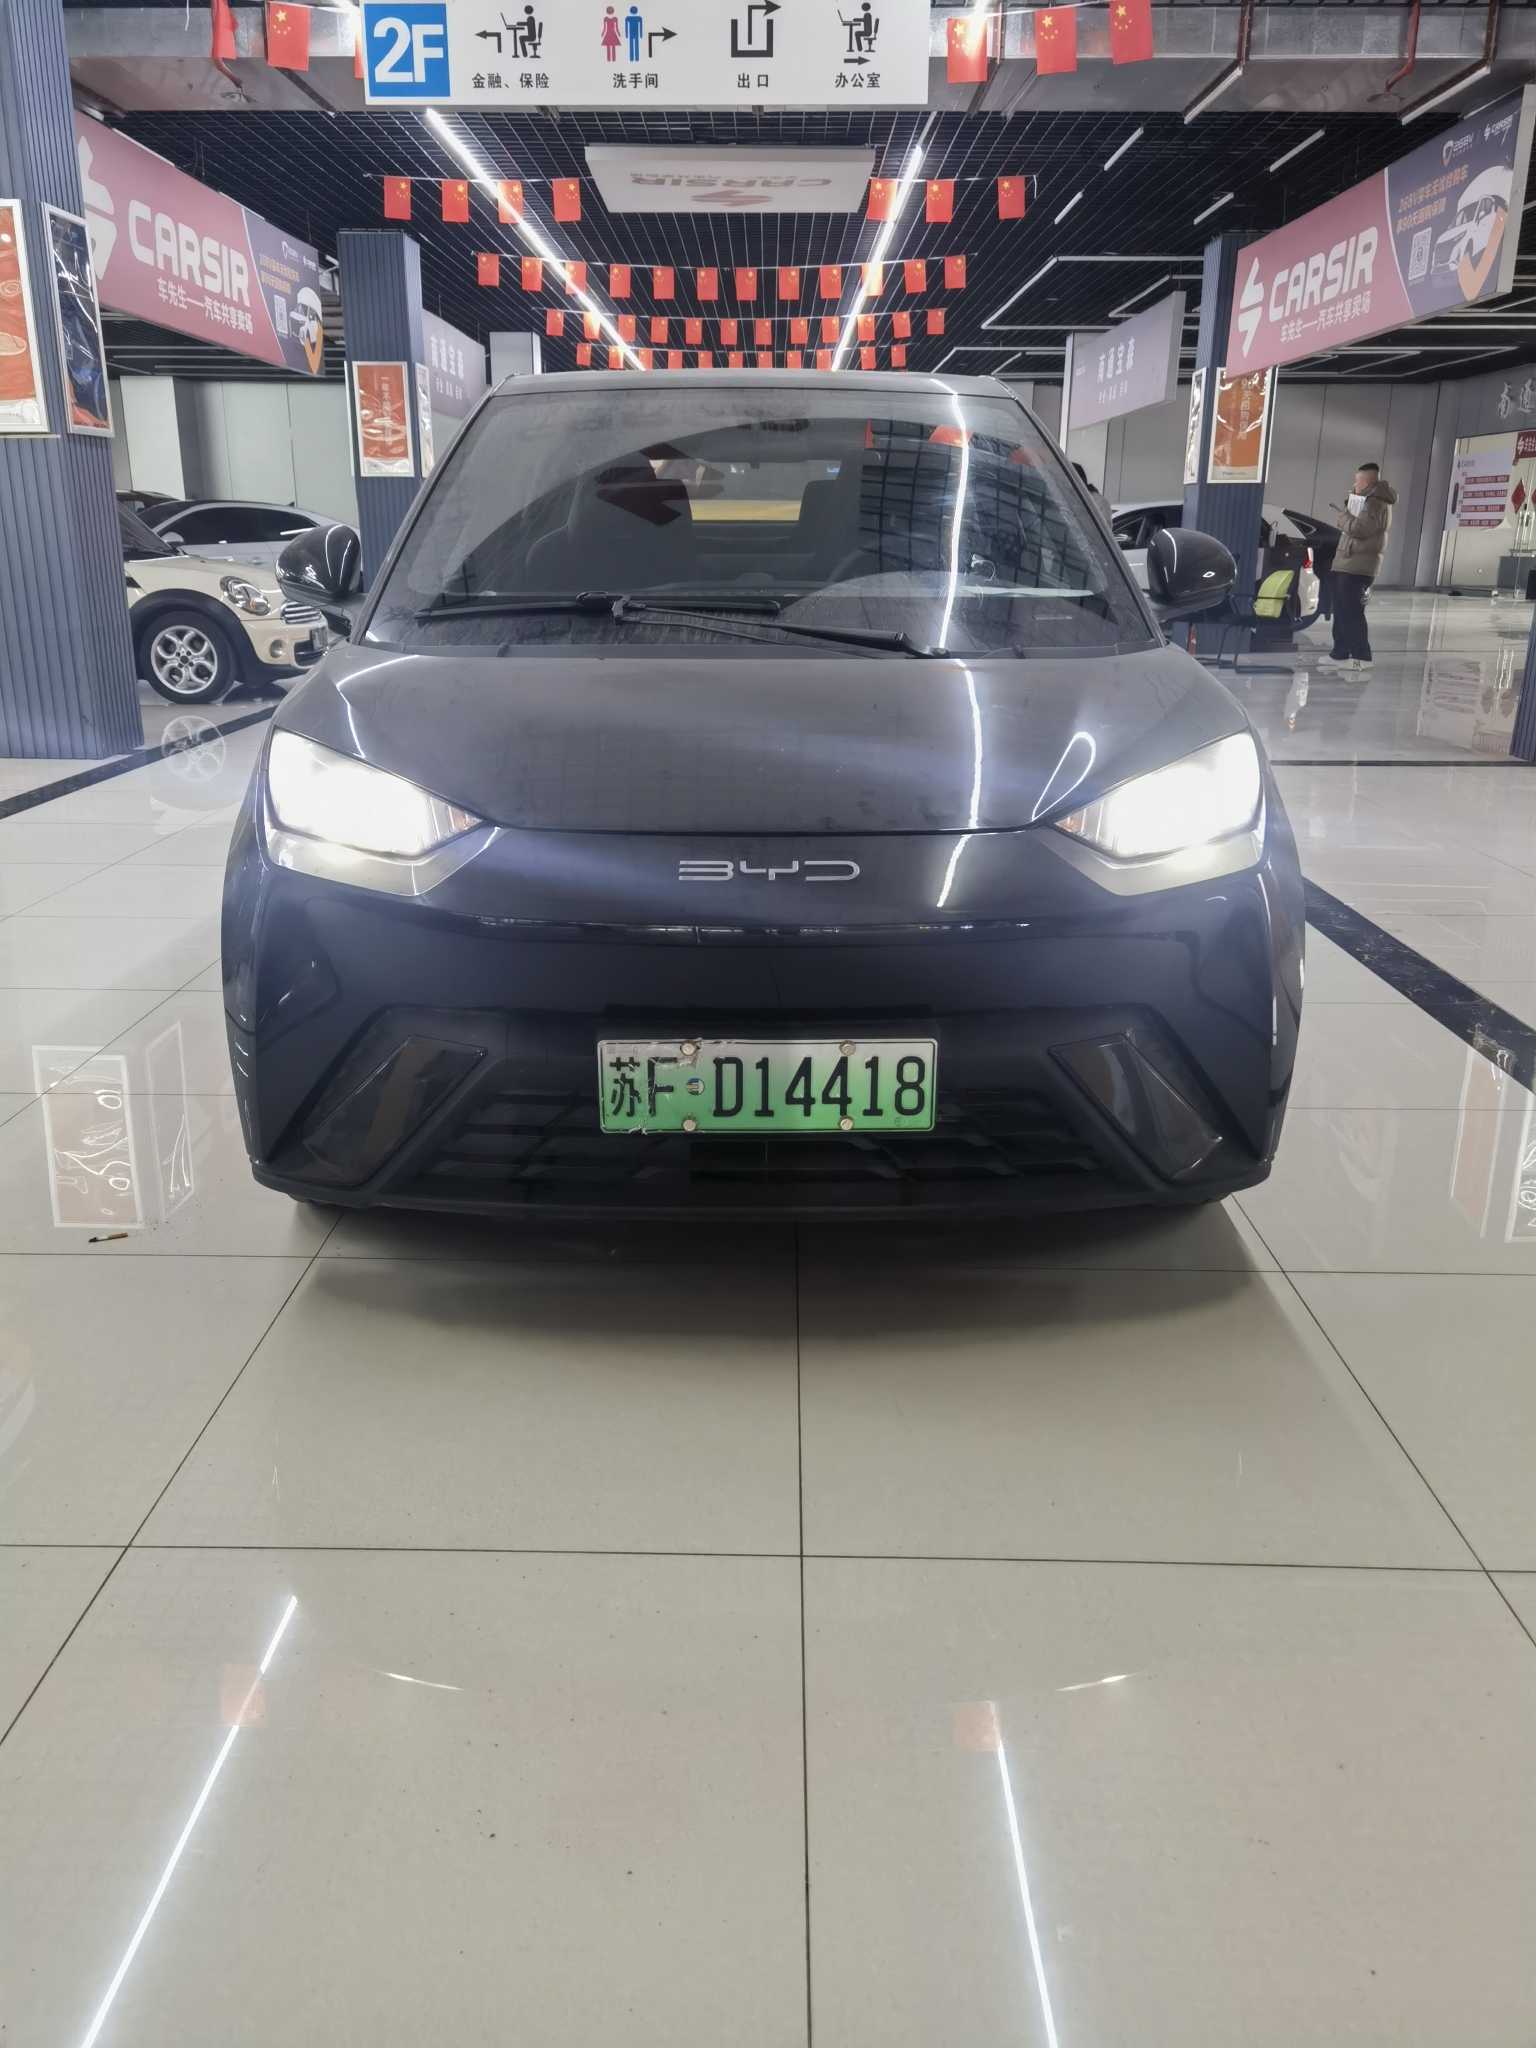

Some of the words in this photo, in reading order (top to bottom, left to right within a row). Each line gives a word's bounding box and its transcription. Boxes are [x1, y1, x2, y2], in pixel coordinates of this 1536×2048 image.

[373, 17, 444, 83] 2F
[472, 72, 550, 89] 金融、保险
[613, 73, 659, 88] 洗手间
[737, 74, 769, 89] 出口
[835, 73, 881, 88] 办公室
[128, 199, 251, 307] CARSIR
[1269, 226, 1378, 322] CARSIR
[678, 860, 861, 881] BYD
